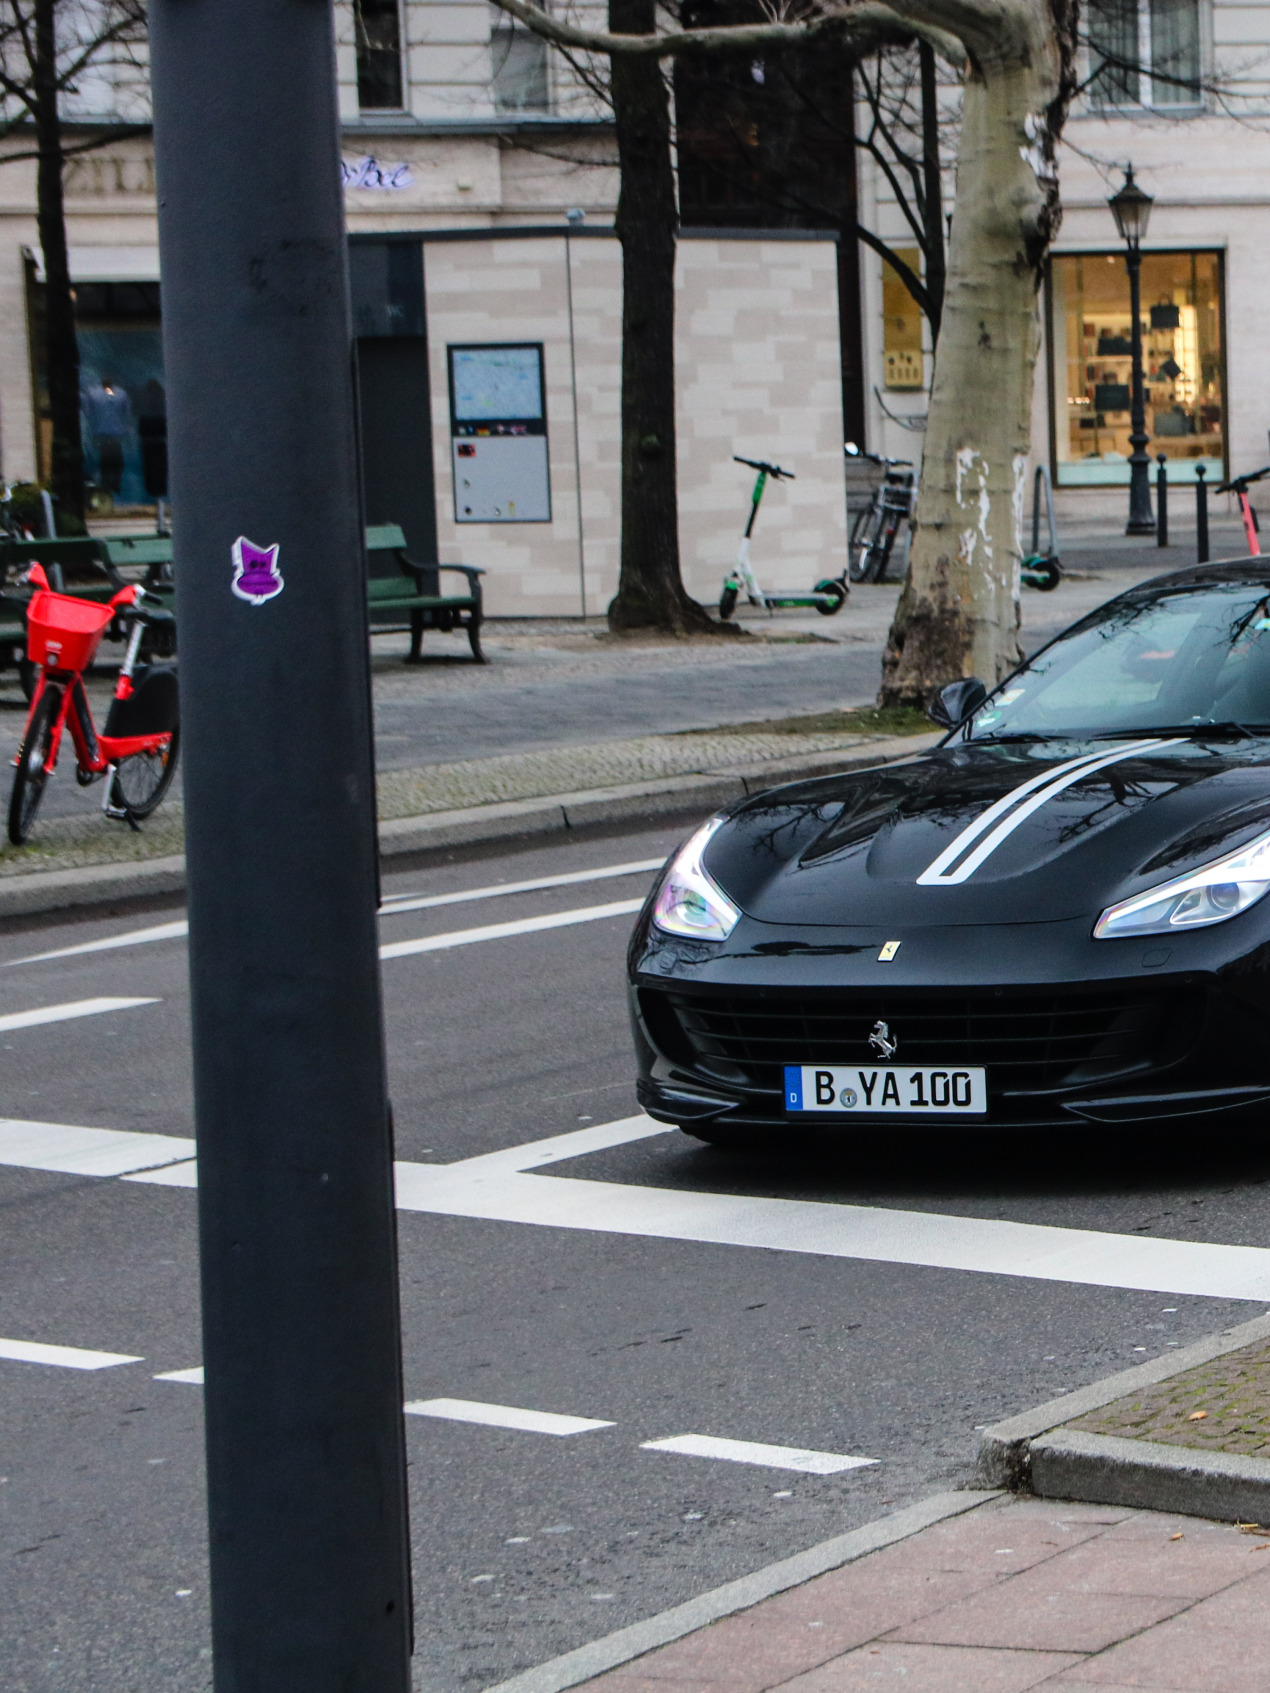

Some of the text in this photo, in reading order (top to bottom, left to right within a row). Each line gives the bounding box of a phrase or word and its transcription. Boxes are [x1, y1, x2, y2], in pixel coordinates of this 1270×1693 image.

[815, 1070, 836, 1105] B
[858, 1071, 900, 1106] YA
[909, 1071, 972, 1107] 100
